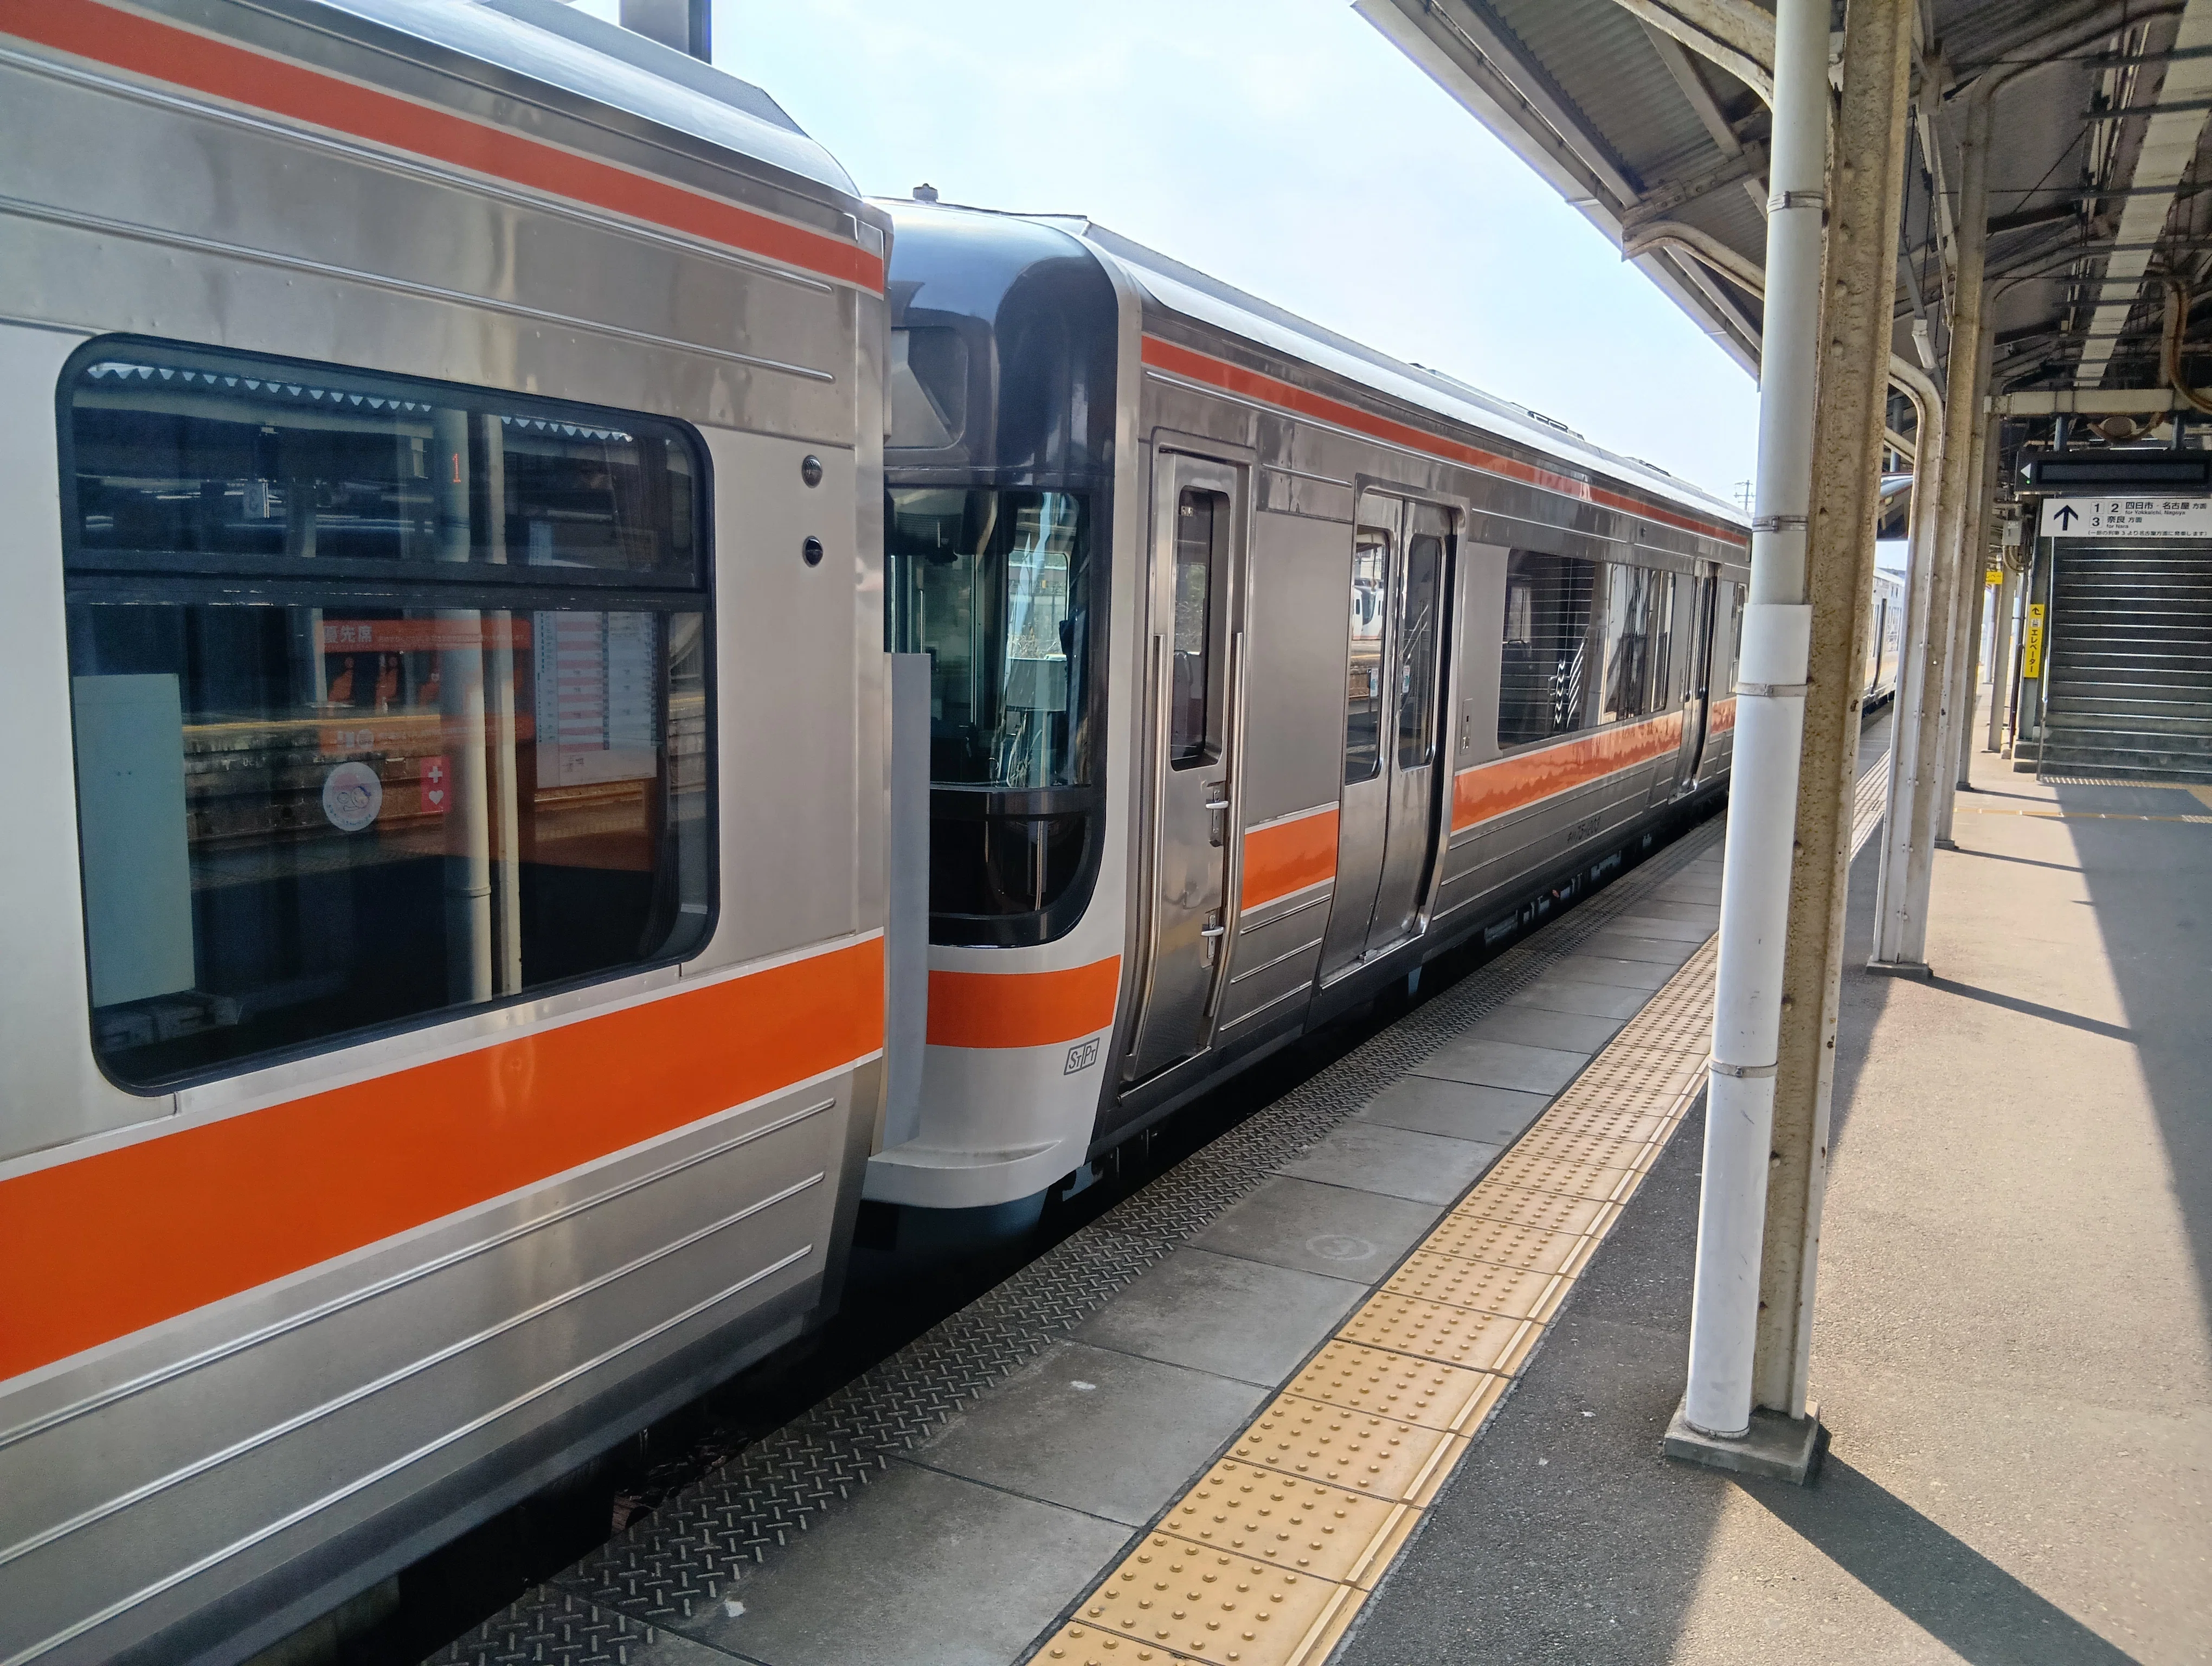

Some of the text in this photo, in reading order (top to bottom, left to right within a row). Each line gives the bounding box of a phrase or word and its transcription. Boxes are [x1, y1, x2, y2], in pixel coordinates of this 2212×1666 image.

[452, 453, 461, 483] 1
[2094, 503, 2100, 513] 1
[2111, 503, 2119, 513] 2
[2092, 517, 2100, 527] 3
[2029, 629, 2039, 672] エレベーター
